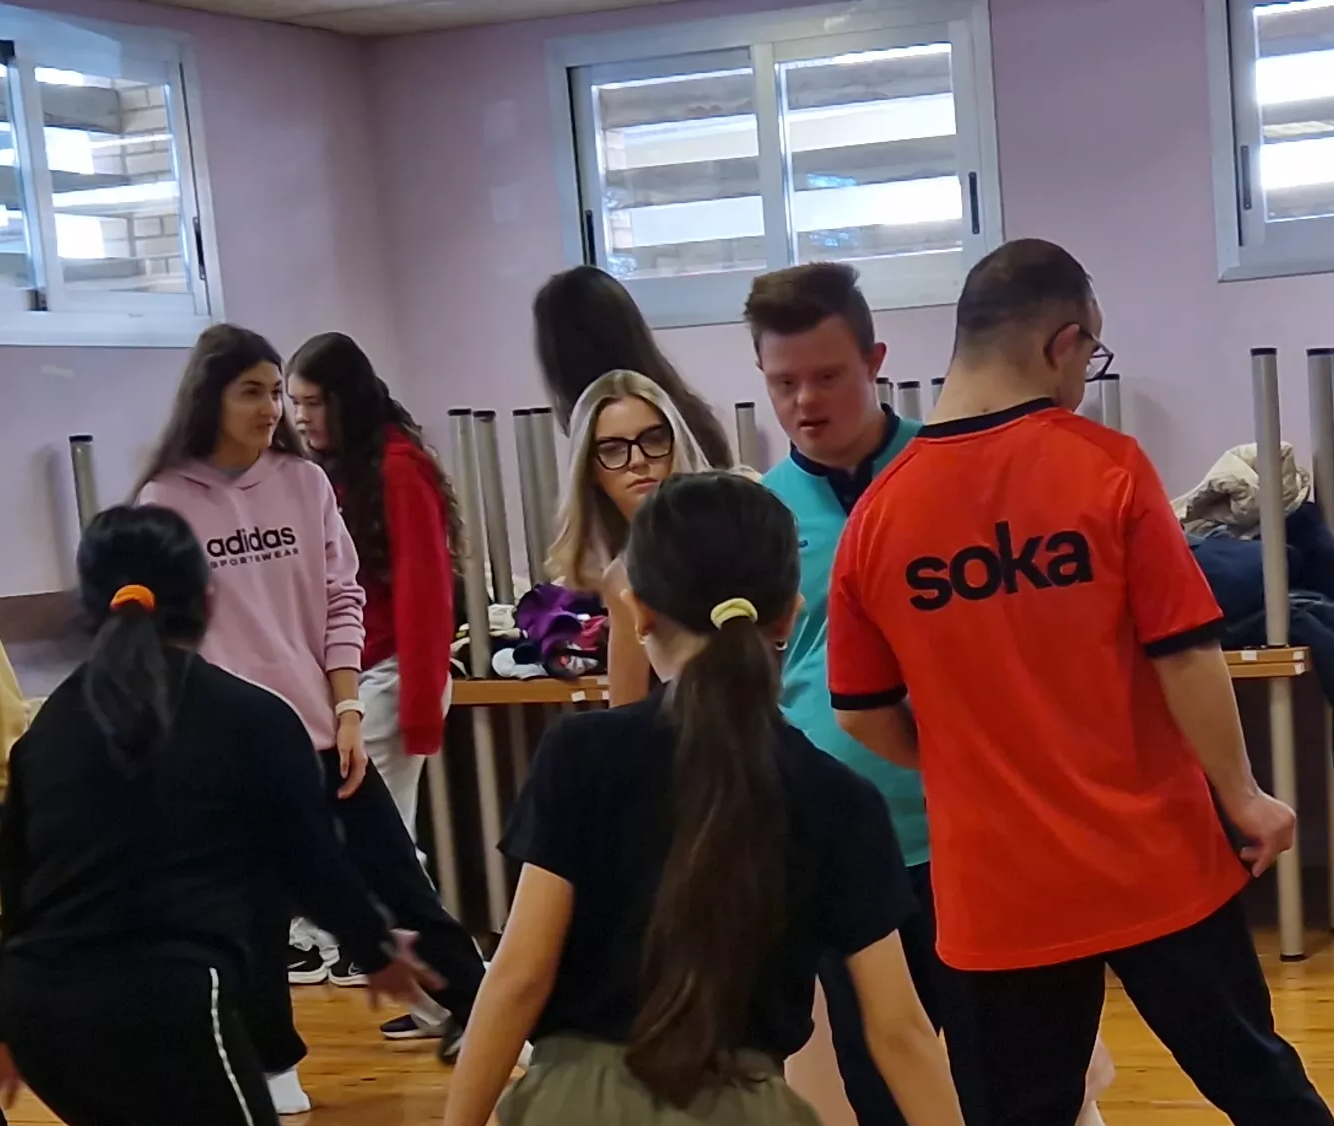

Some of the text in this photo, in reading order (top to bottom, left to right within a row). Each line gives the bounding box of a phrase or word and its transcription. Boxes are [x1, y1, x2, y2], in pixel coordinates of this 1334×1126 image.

[207, 526, 296, 557] adidas
[210, 547, 299, 569] SPORTSWEAR
[905, 520, 1094, 611] soka
